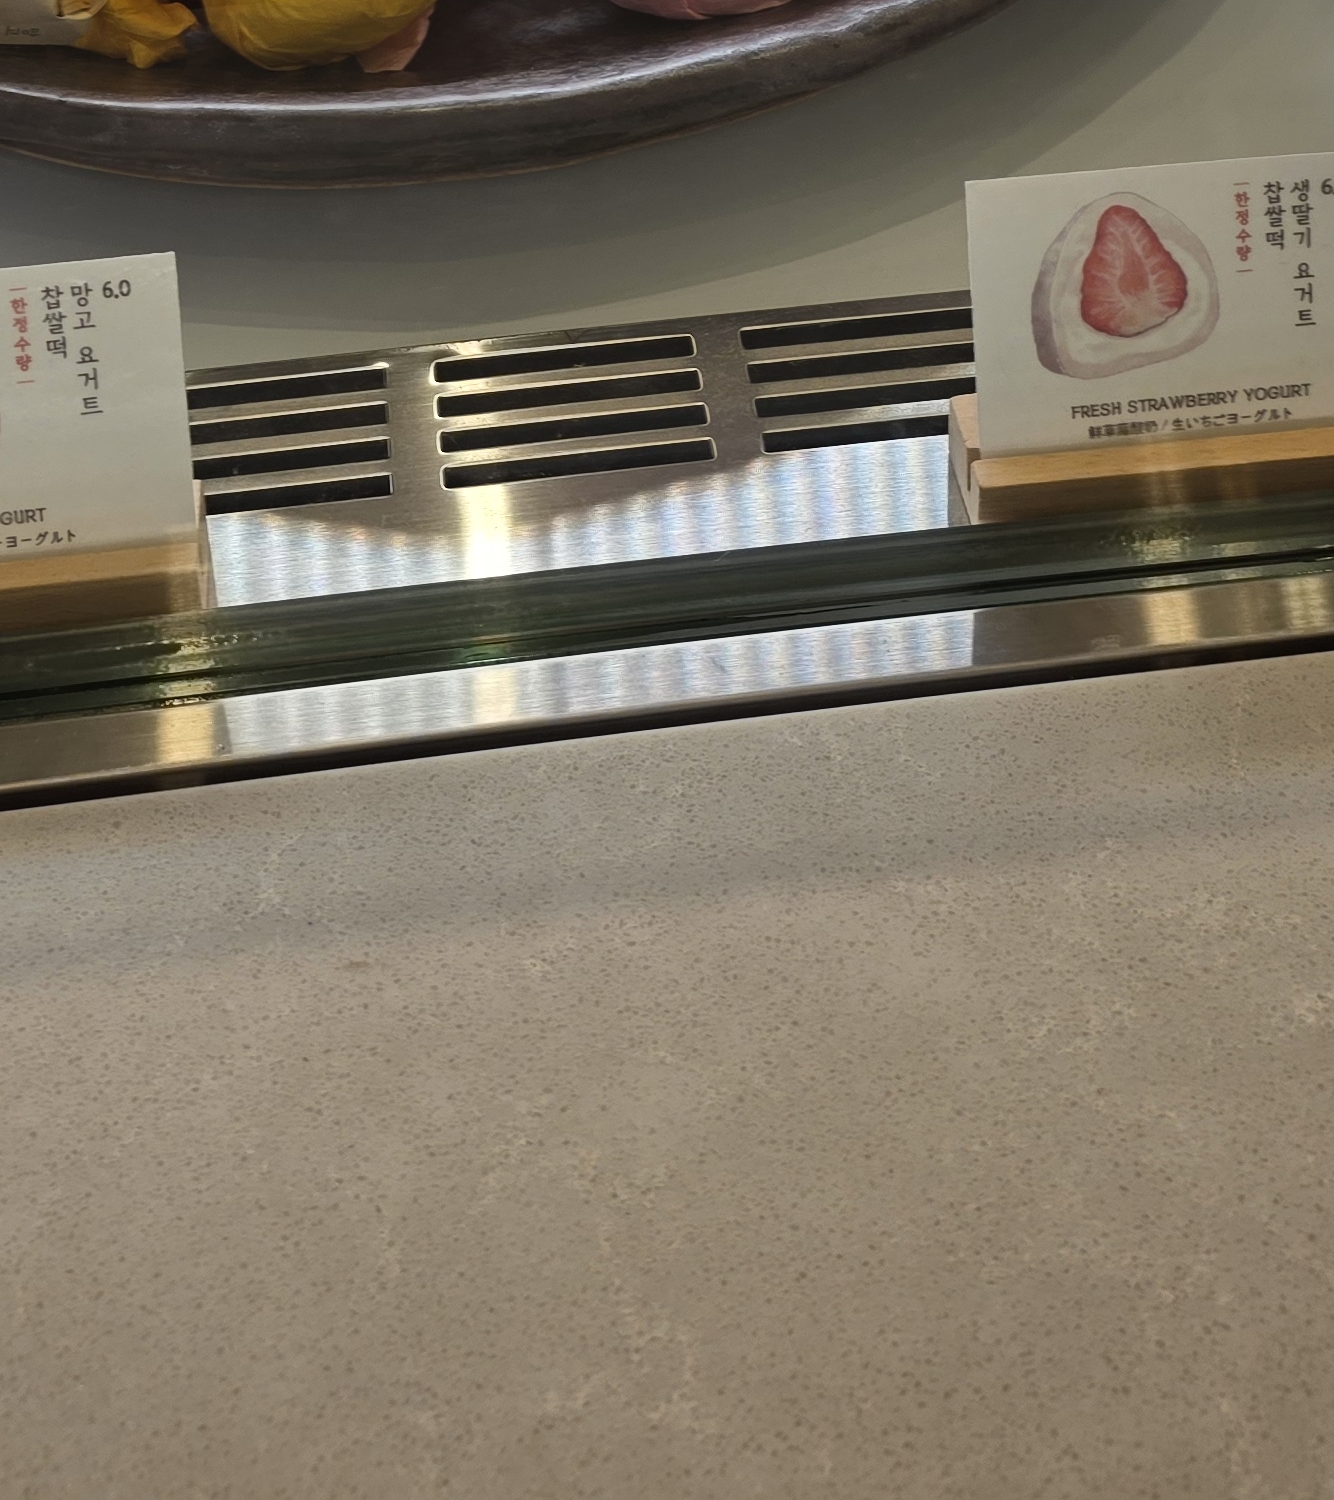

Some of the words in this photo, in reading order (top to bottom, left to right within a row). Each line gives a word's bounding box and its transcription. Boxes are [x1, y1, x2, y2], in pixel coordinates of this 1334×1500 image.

[1233, 191, 1253, 262] 한정수량
[1263, 180, 1287, 251] 찹쌀떡
[1290, 178, 1314, 249] 생딸기
[41, 285, 68, 359] 찹쌀떡
[70, 282, 96, 330] 망고
[101, 279, 132, 299] 6.0
[1292, 262, 1317, 327] 요거트
[9, 297, 33, 372] 한정수량
[76, 346, 104, 415] 요거트
[1070, 401, 1122, 419] FRESH
[1127, 389, 1239, 414] STRAWBERRY
[1242, 382, 1312, 402] YOGURT
[1171, 407, 1293, 431] 生いちごヨーグルト
